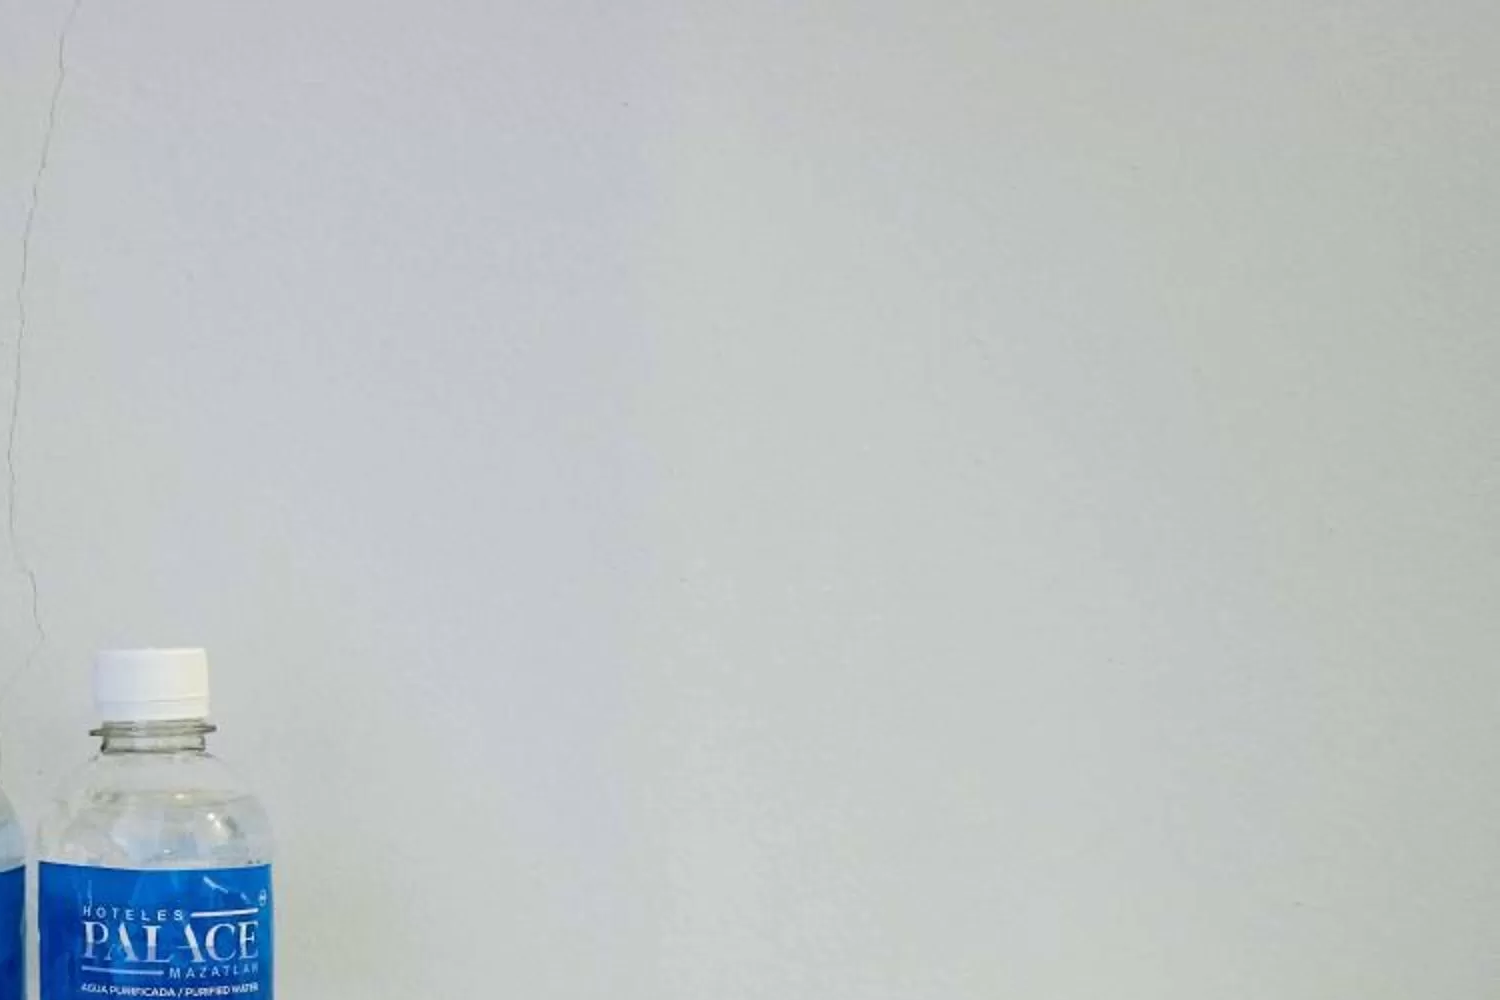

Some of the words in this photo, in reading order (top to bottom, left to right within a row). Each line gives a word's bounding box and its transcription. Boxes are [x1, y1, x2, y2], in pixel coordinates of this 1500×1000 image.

[83, 905, 184, 921] HOTELES
[81, 920, 260, 963] PALACE
[81, 983, 108, 994] AGUA
[185, 986, 230, 997] PURIFIED
